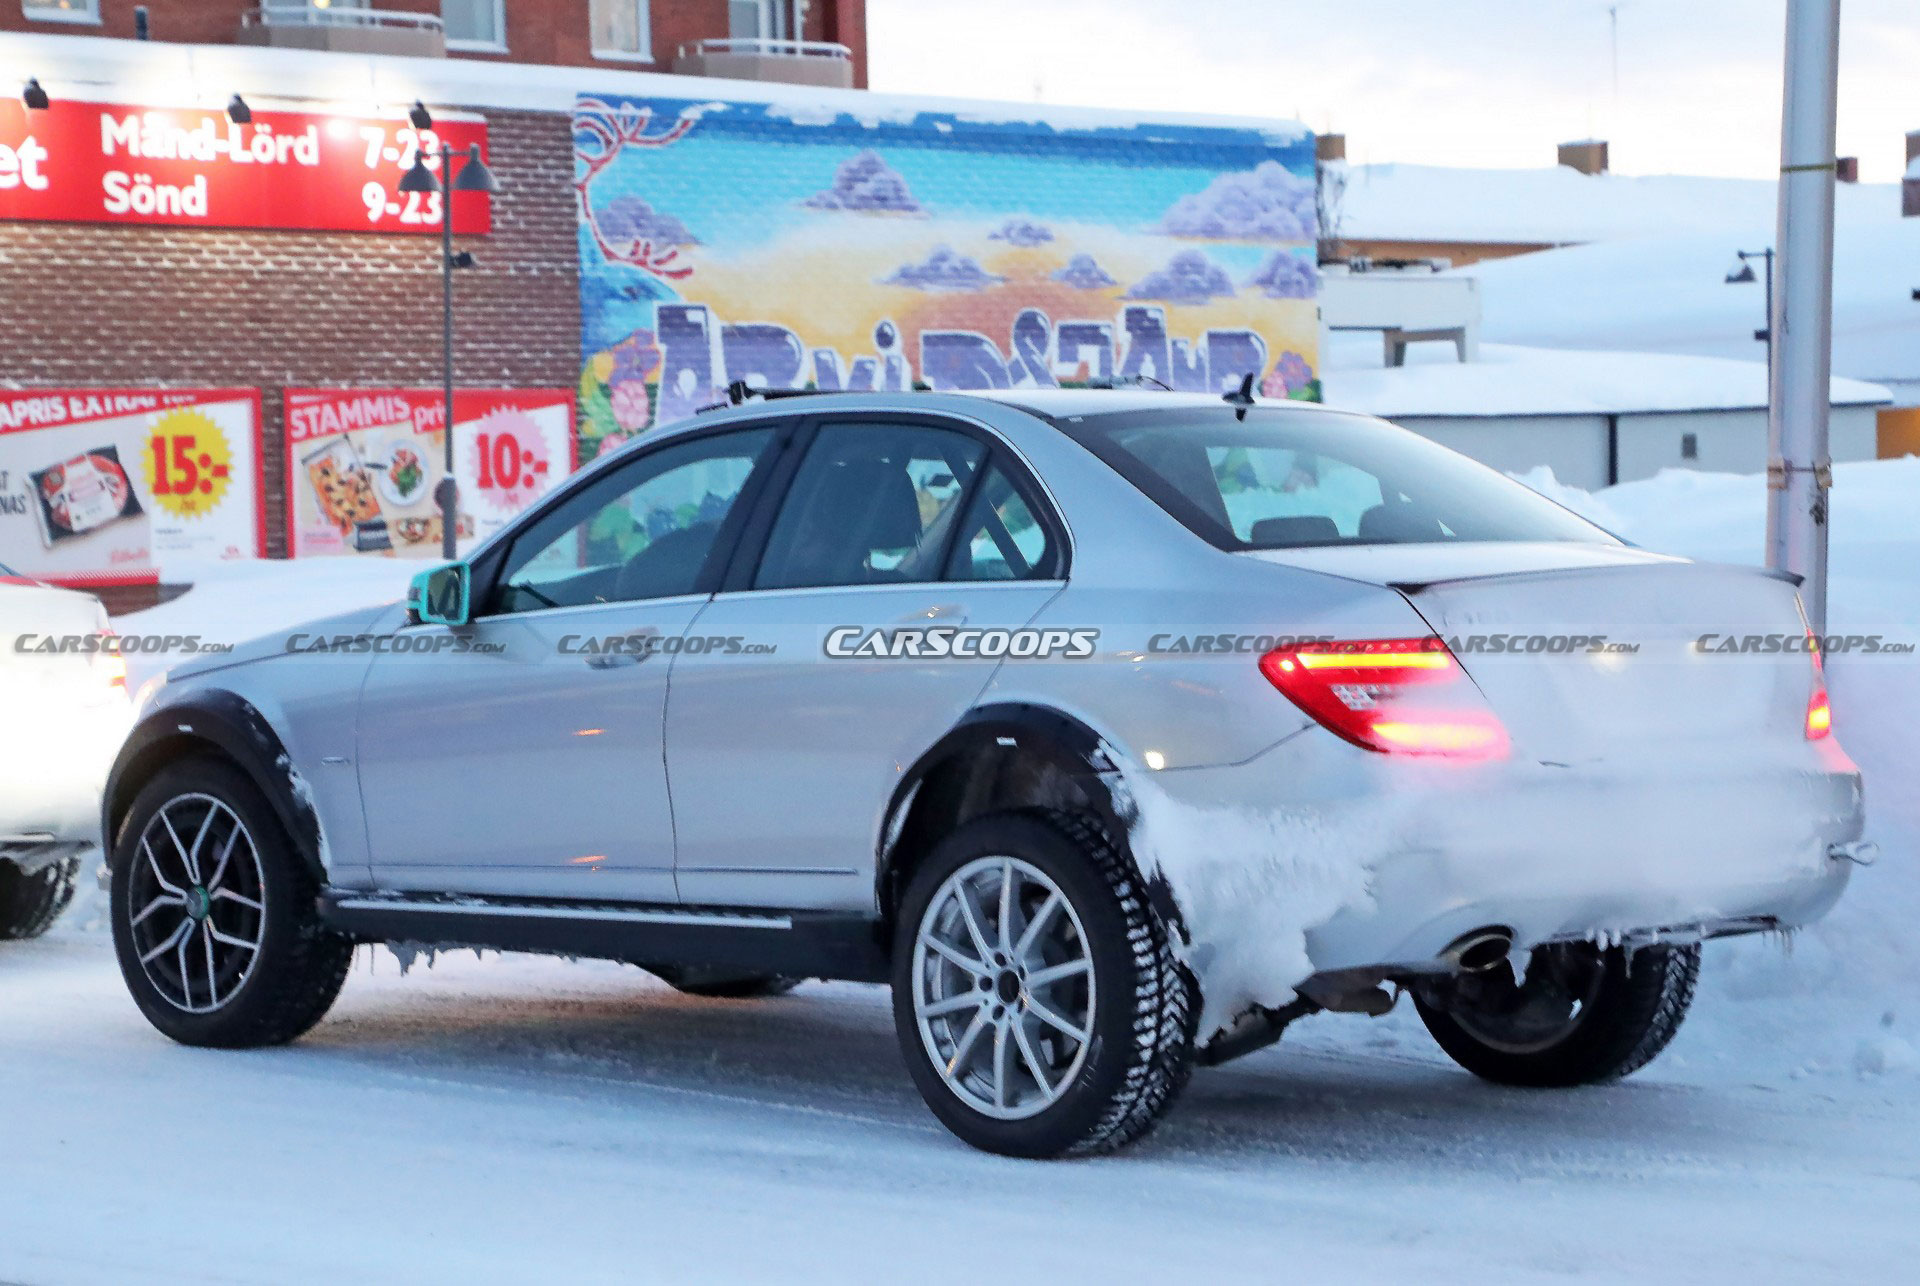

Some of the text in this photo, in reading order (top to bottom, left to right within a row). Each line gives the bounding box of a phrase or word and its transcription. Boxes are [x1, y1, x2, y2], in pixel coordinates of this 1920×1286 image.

[101, 110, 442, 170] Månd-Lörd 7-23
[102, 170, 443, 224] Sönd 9-23
[290, 395, 447, 439] STAMMIS pri
[151, 434, 230, 496] 15:-
[475, 432, 548, 489] 10:-
